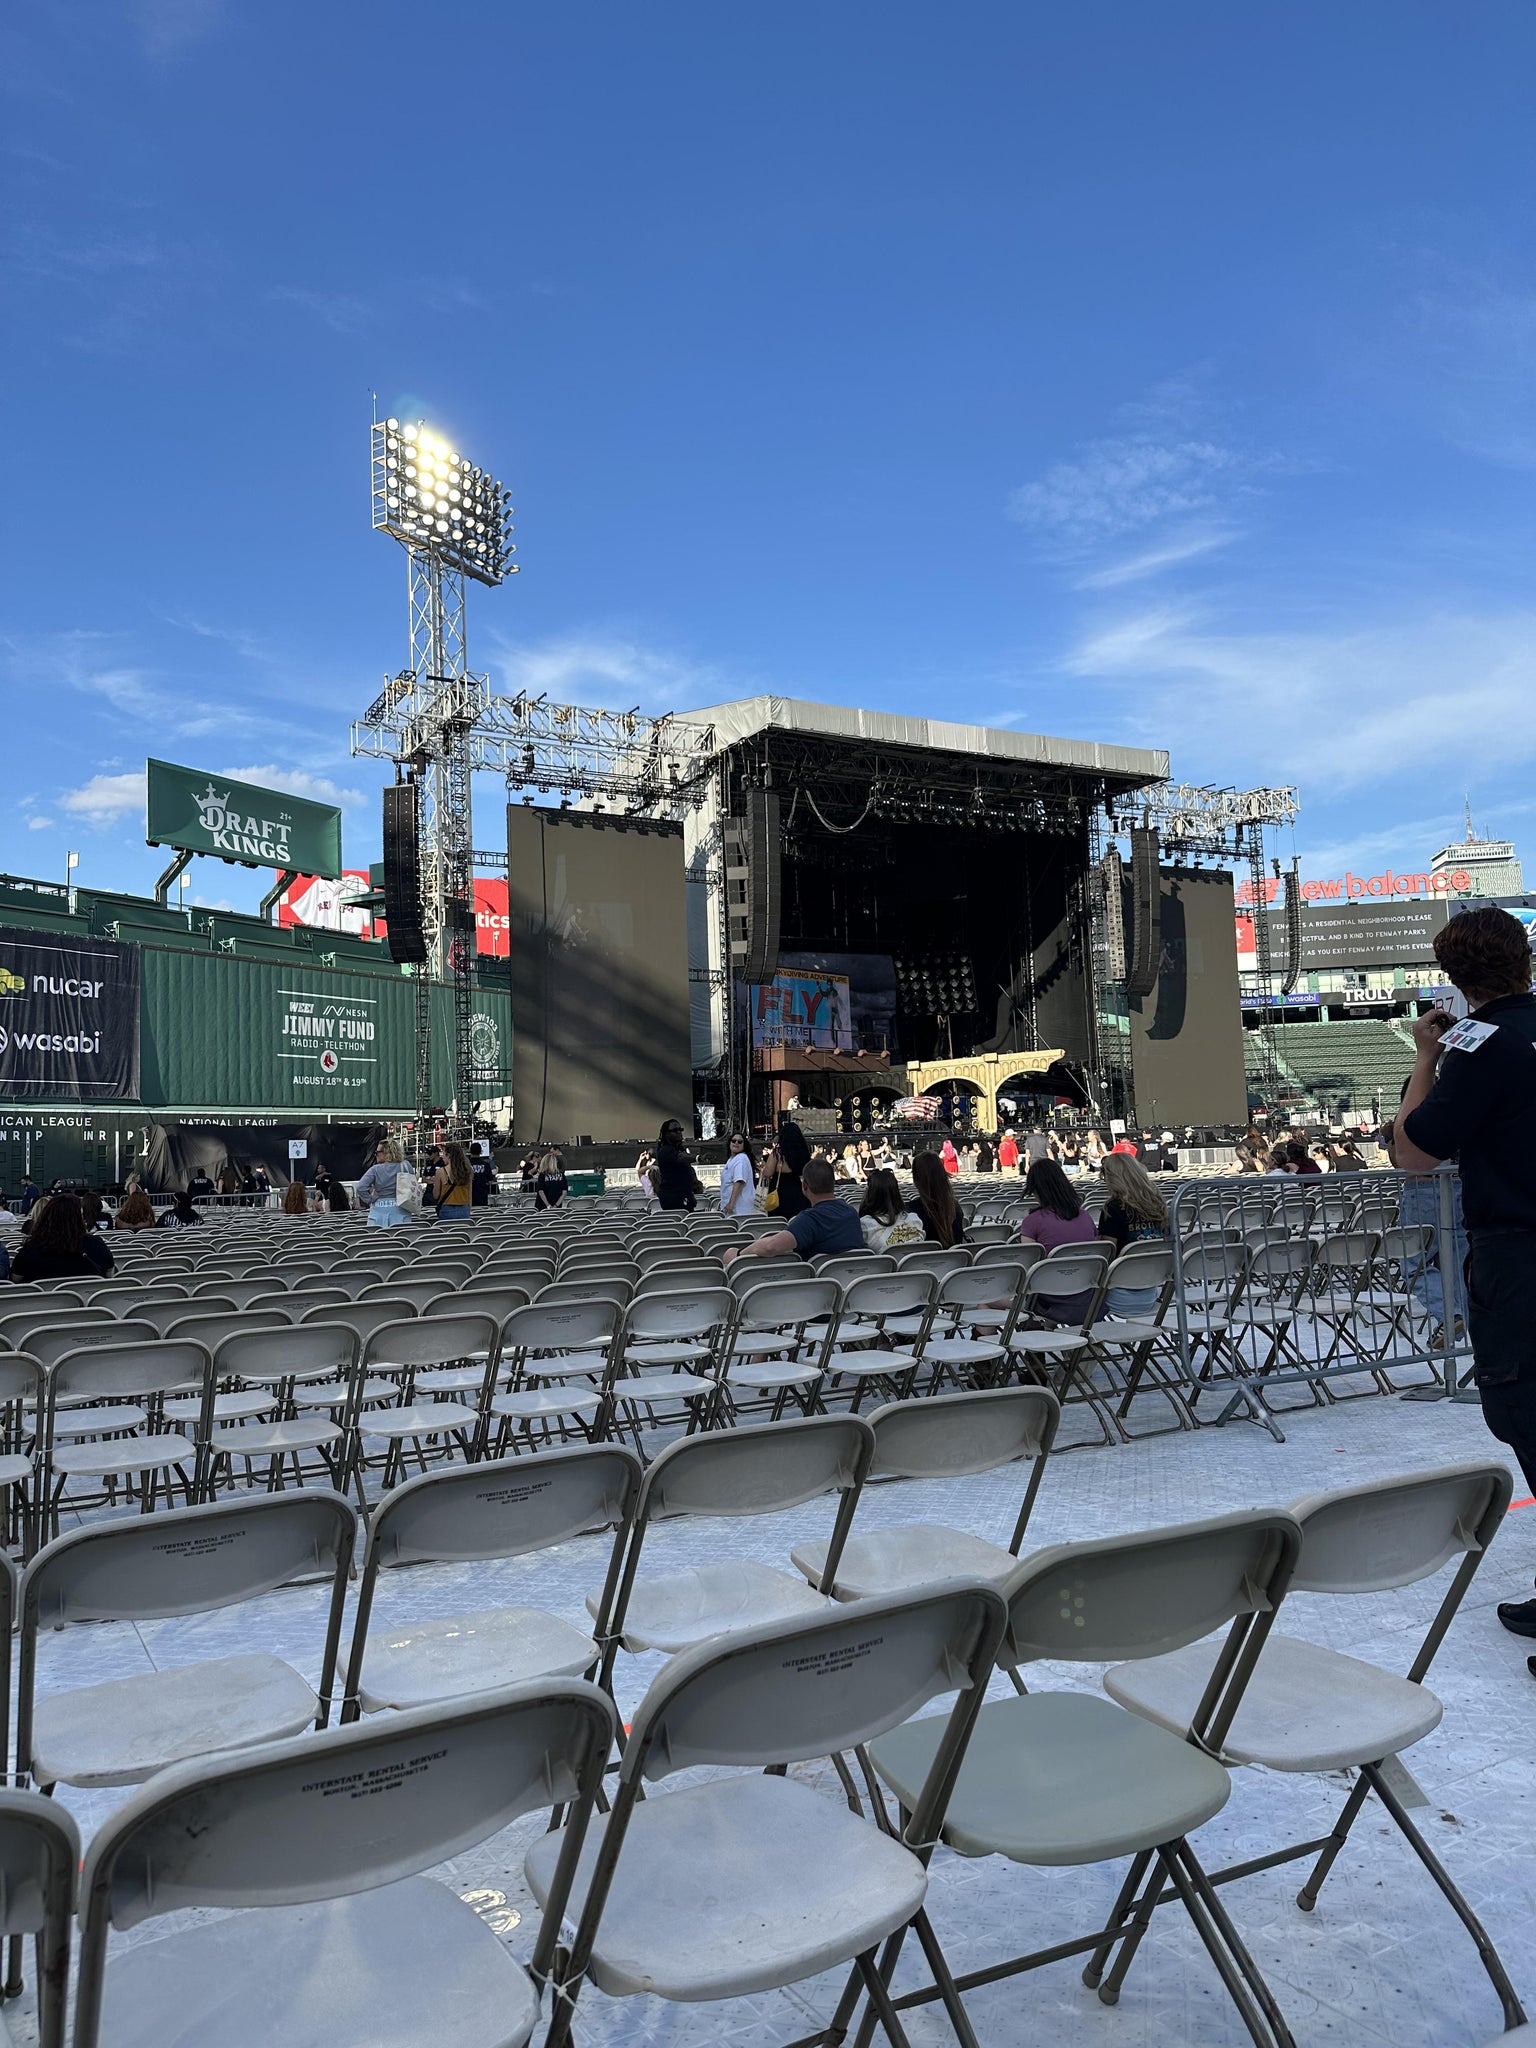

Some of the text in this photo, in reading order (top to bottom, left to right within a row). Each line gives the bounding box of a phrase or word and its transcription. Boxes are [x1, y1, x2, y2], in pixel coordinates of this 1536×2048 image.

[198, 806, 292, 844] DRAFT
[212, 829, 292, 863] KINGS
[1345, 869, 1471, 898] balance
[1315, 919, 1356, 928] RESIDENTIAL
[1357, 915, 1406, 925] NEIGHBORHOOD
[1407, 913, 1433, 922] PLEASE
[1375, 929, 1402, 938] FENWAY
[1403, 928, 1427, 936] PARK'S
[1332, 947, 1347, 955] EXIT
[1348, 945, 1375, 953] FENWAY
[1376, 944, 1394, 952] PARK
[33, 975, 104, 998] nucar
[1287, 994, 1317, 1003] wasabi
[1342, 986, 1395, 1002] TRULY
[757, 985, 824, 1026] FLY
[346, 1008, 367, 1018] NESN
[282, 1015, 375, 1041] JIMMY FUND
[13, 1030, 100, 1054] wasabi
[293, 1075, 325, 1086] AUGUST
[343, 1078, 350, 1087] &
[41, 1116, 92, 1127] LEAGUE
[179, 1118, 234, 1127] NATIONAL
[35, 1130, 43, 1141] P
[83, 1130, 134, 1141] IN R P
[292, 1141, 304, 1149] A7
[194, 1536, 218, 1545] RENTAL
[781, 1653, 827, 1669] INTERSTATE
[829, 1646, 855, 1659] RENTAL
[857, 1637, 883, 1651] SERVICE
[302, 1749, 448, 1792] INTERSTATE RENTAL SERVICE
